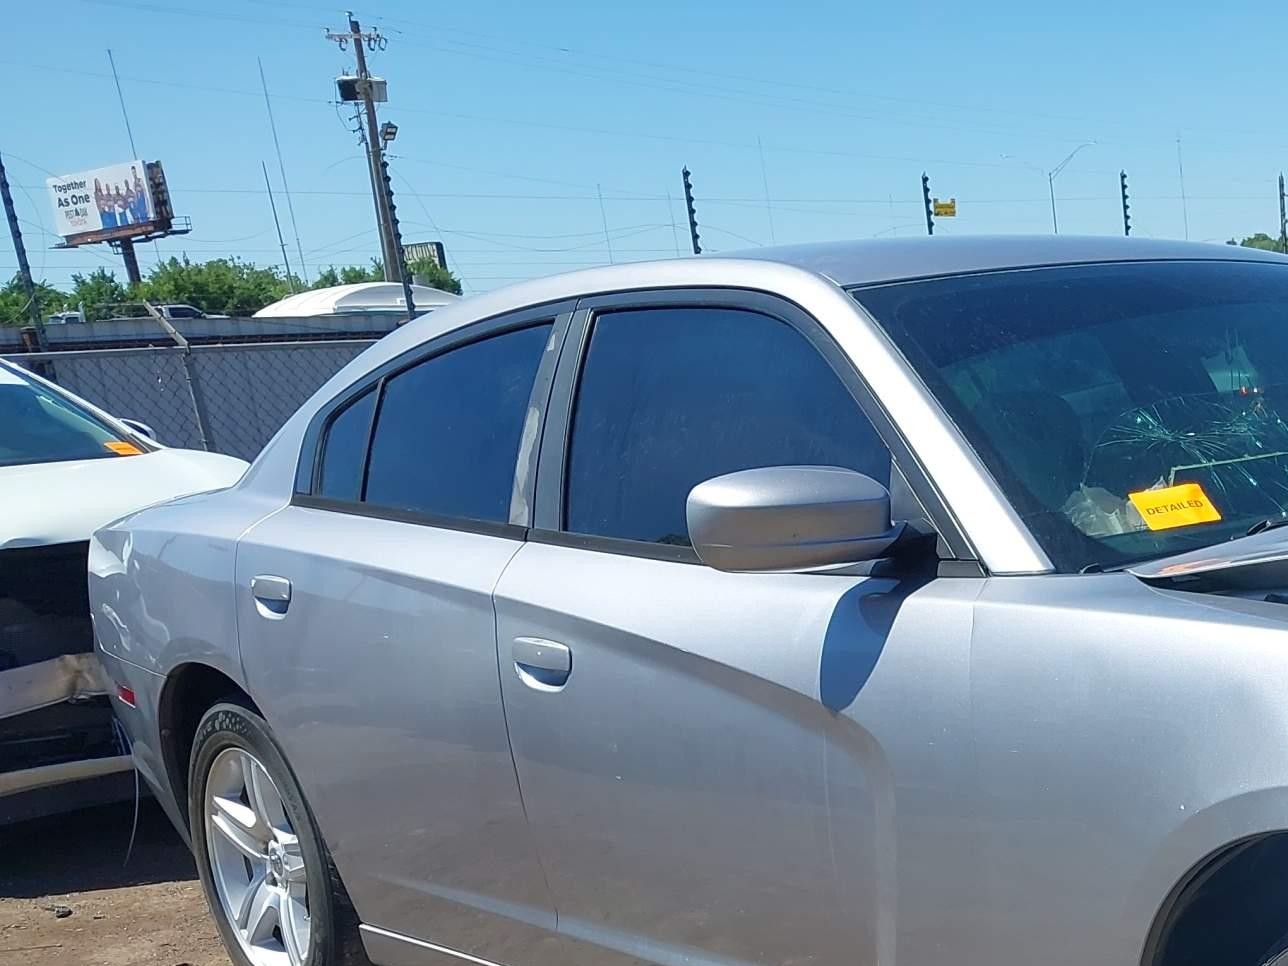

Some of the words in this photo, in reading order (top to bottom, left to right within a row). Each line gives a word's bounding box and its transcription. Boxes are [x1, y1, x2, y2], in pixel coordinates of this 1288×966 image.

[53, 181, 86, 193] Together
[58, 197, 70, 208] As
[71, 194, 90, 205] One
[1145, 500, 1204, 516] DETAILED
